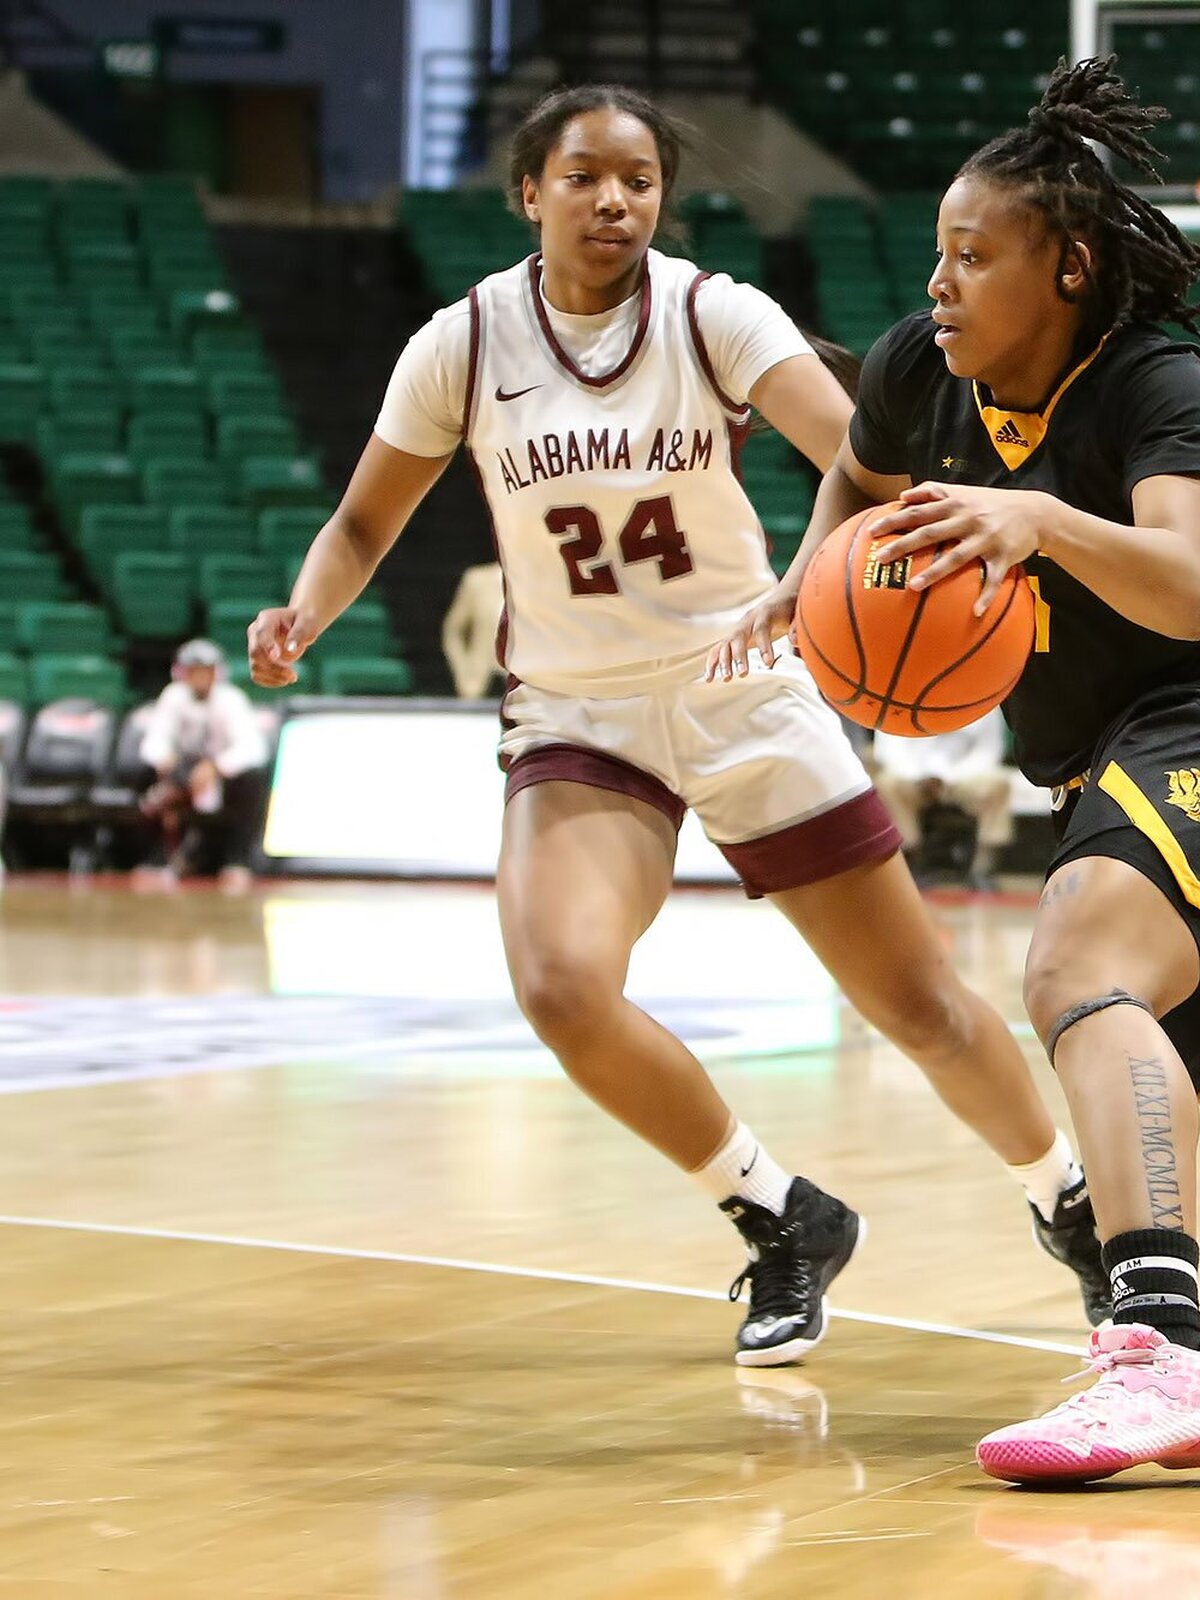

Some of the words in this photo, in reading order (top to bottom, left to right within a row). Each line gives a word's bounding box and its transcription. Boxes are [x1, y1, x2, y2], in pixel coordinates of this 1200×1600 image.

[497, 429, 631, 494] ALABAMA
[646, 428, 713, 472] A&M
[996, 434, 1029, 448] adidas
[543, 491, 697, 598] 24
[1126, 1258, 1142, 1270] AM
